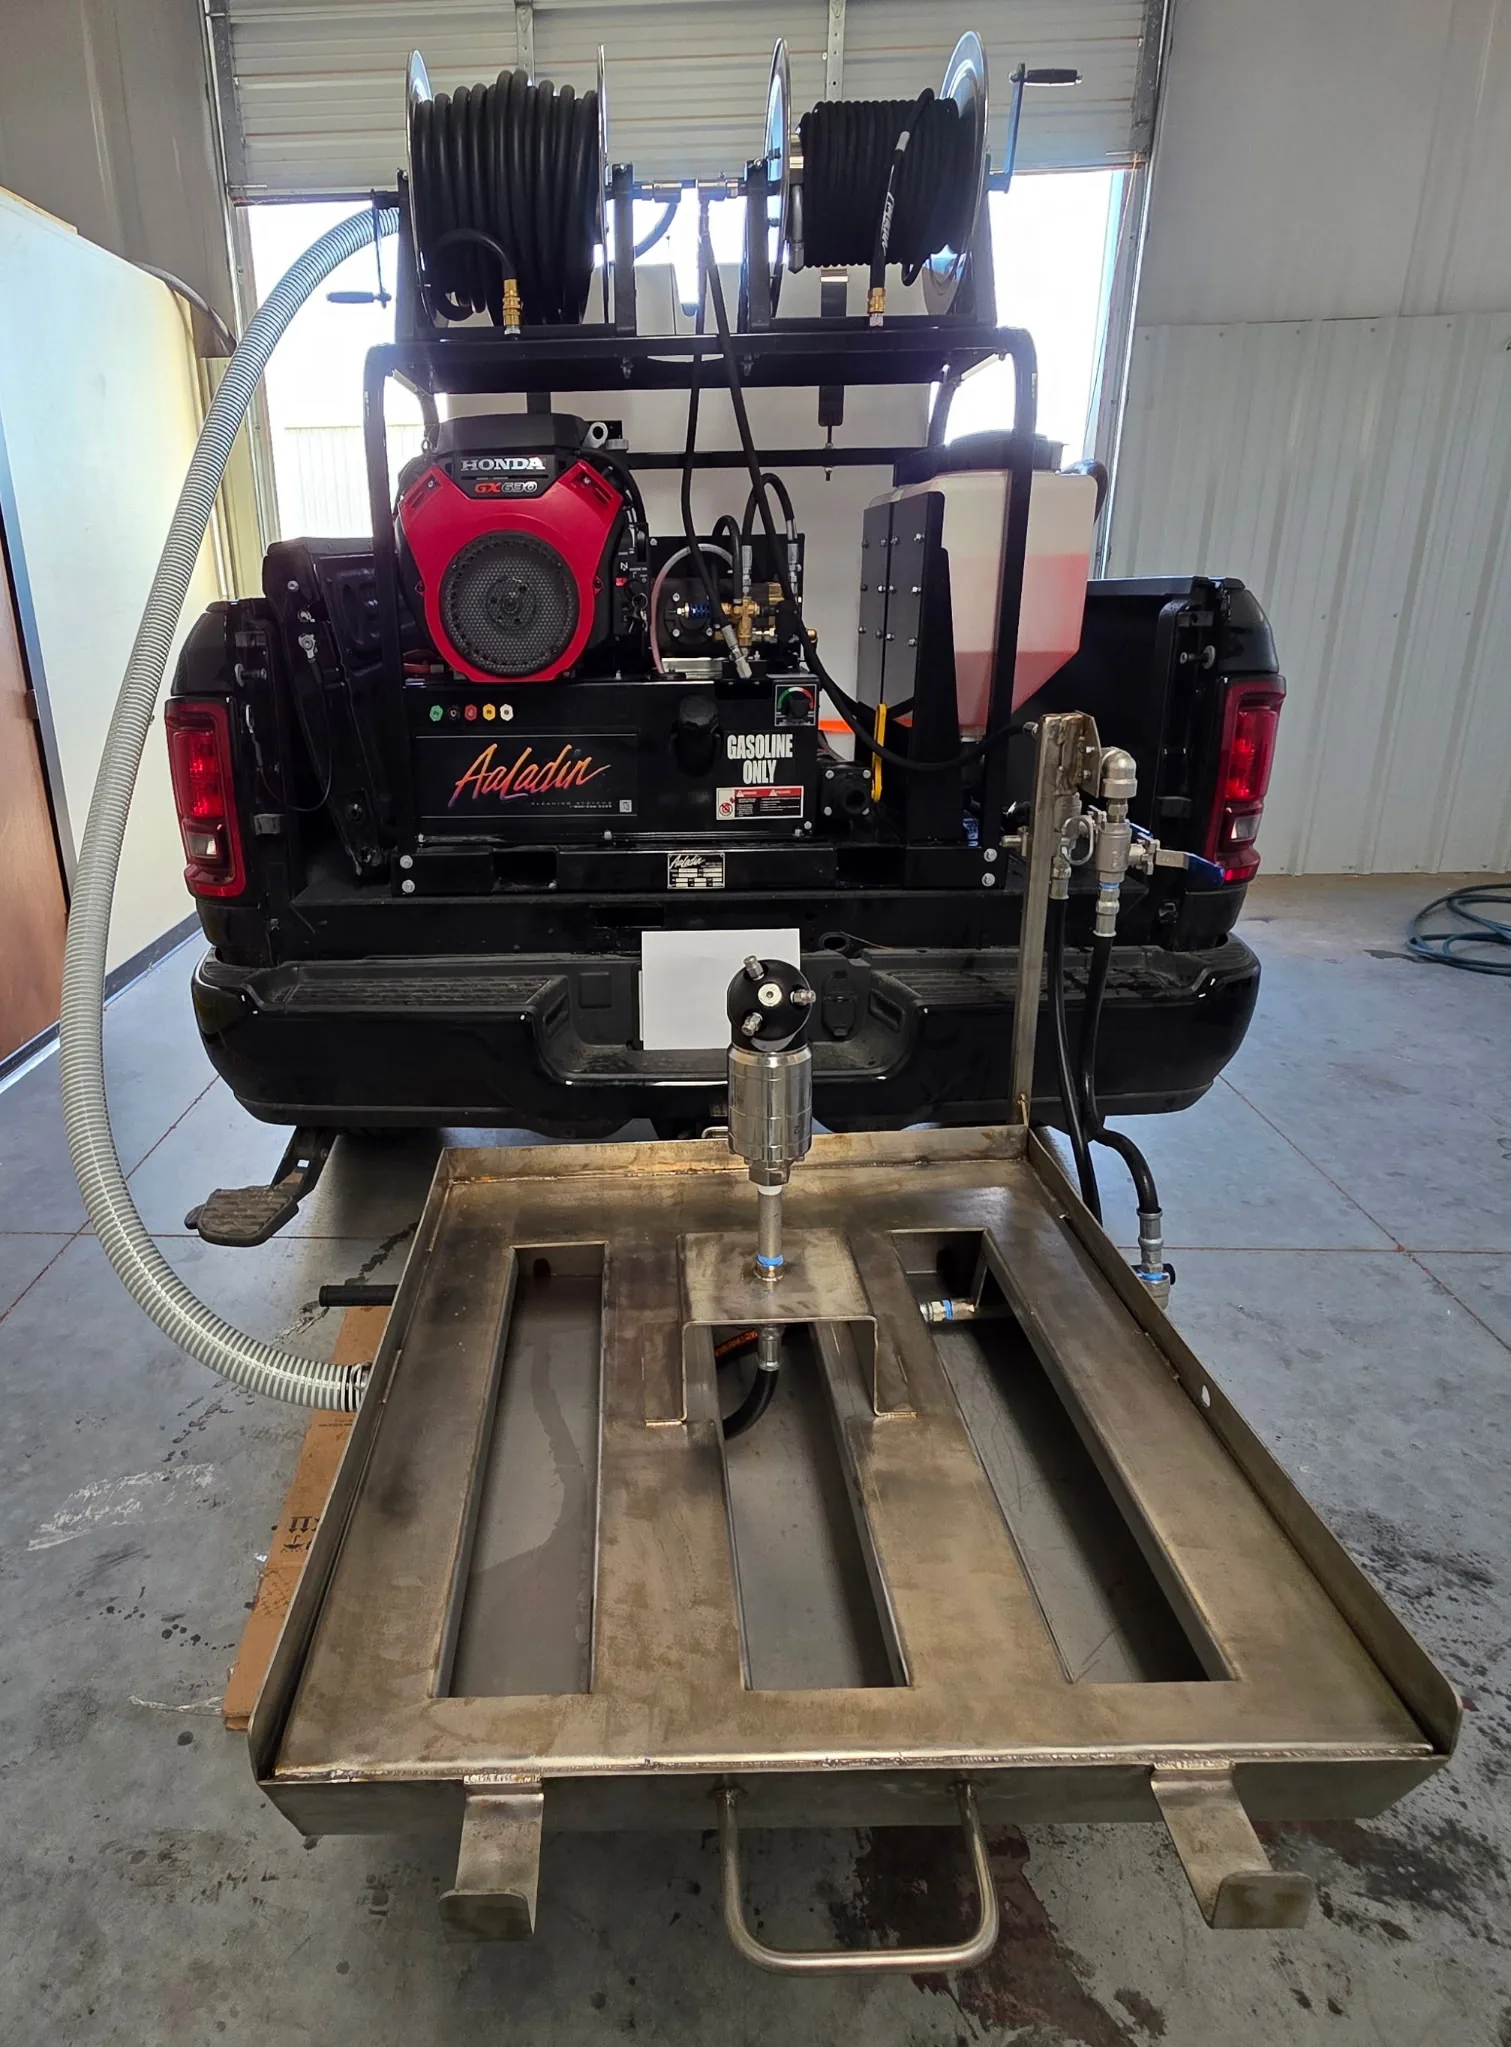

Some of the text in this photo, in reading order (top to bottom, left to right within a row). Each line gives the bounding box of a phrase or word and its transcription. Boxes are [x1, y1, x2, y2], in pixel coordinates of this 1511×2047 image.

[460, 457, 546, 471] HONDA
[727, 734, 793, 759] GASOLINE
[743, 760, 777, 784] ONLY
